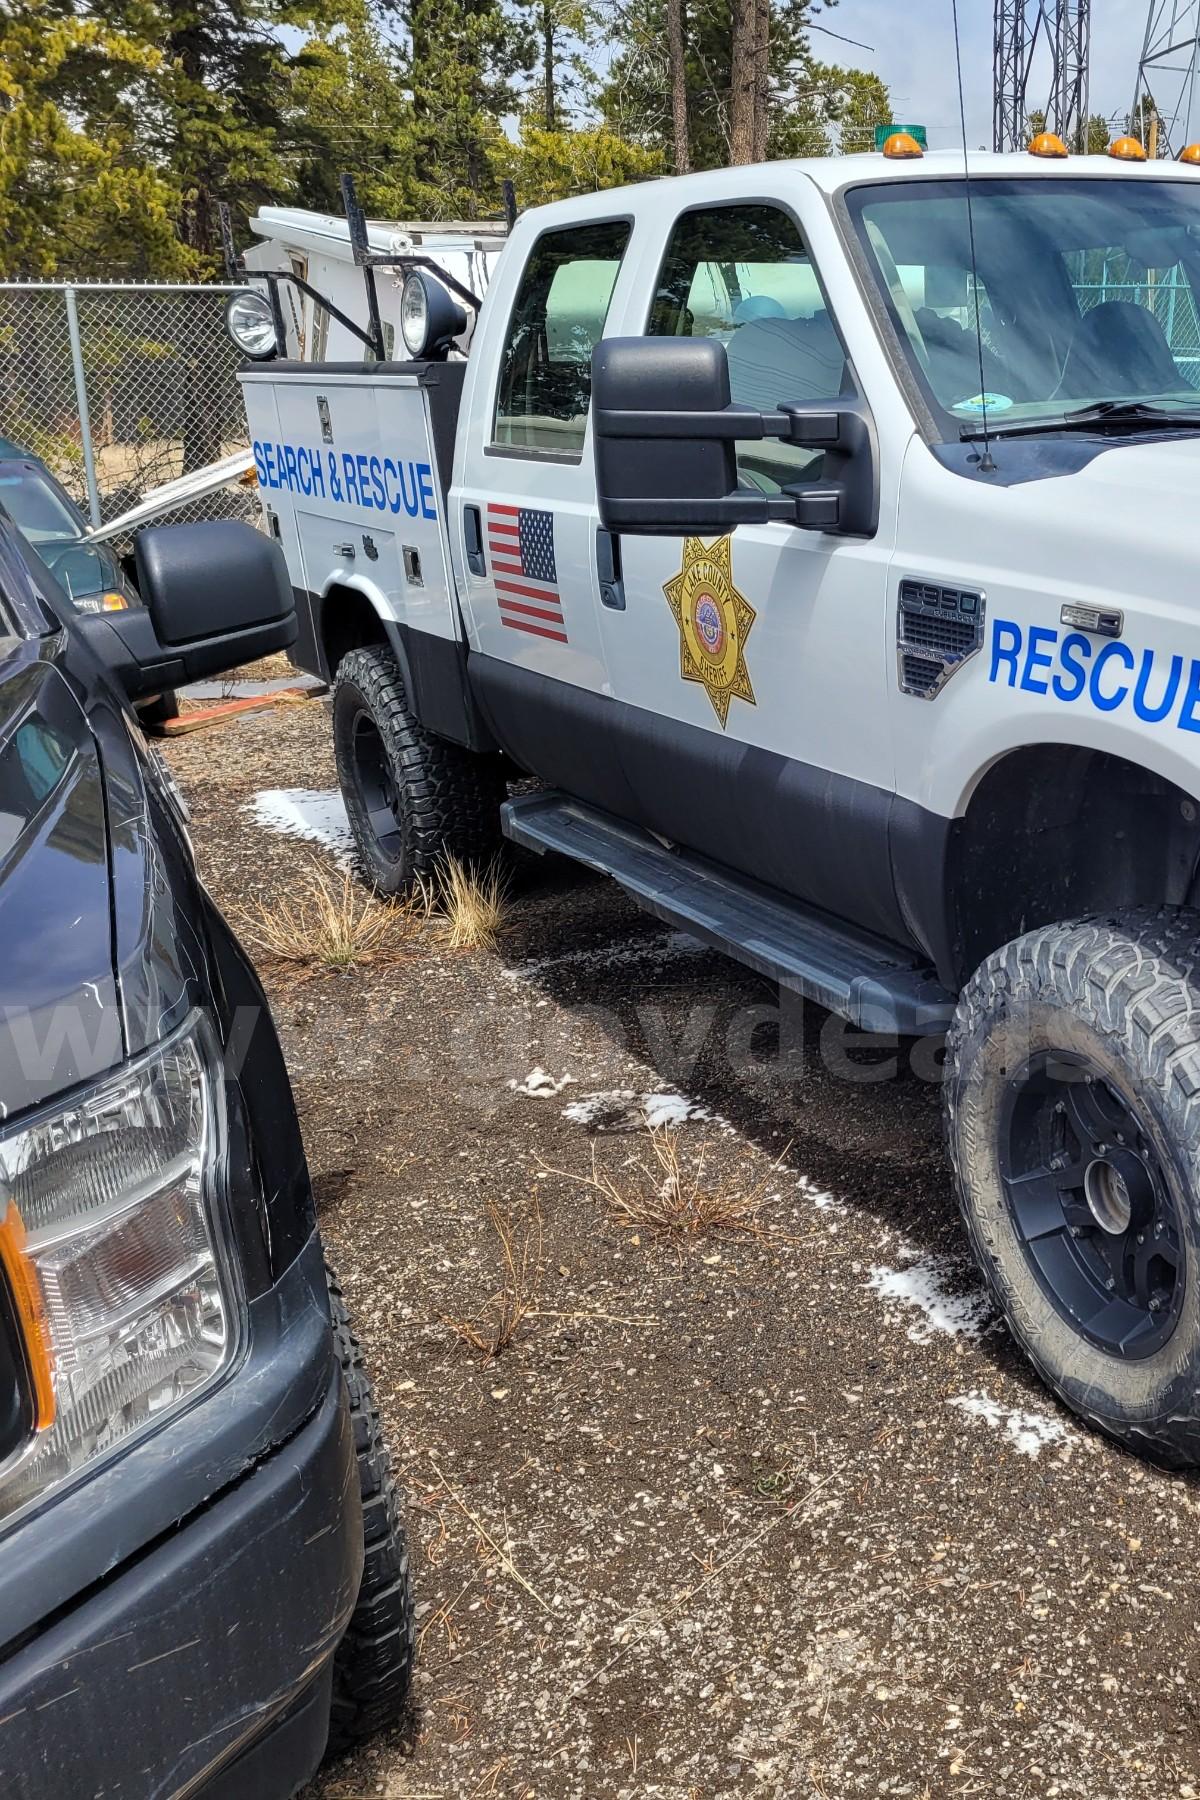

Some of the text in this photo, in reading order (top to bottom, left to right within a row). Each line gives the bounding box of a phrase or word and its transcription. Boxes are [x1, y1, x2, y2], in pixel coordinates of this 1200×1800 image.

[253, 440, 438, 521] SEARCH & RESCUE
[685, 561, 731, 606] LAKE COUNTY
[700, 655, 728, 686] SHERIFF
